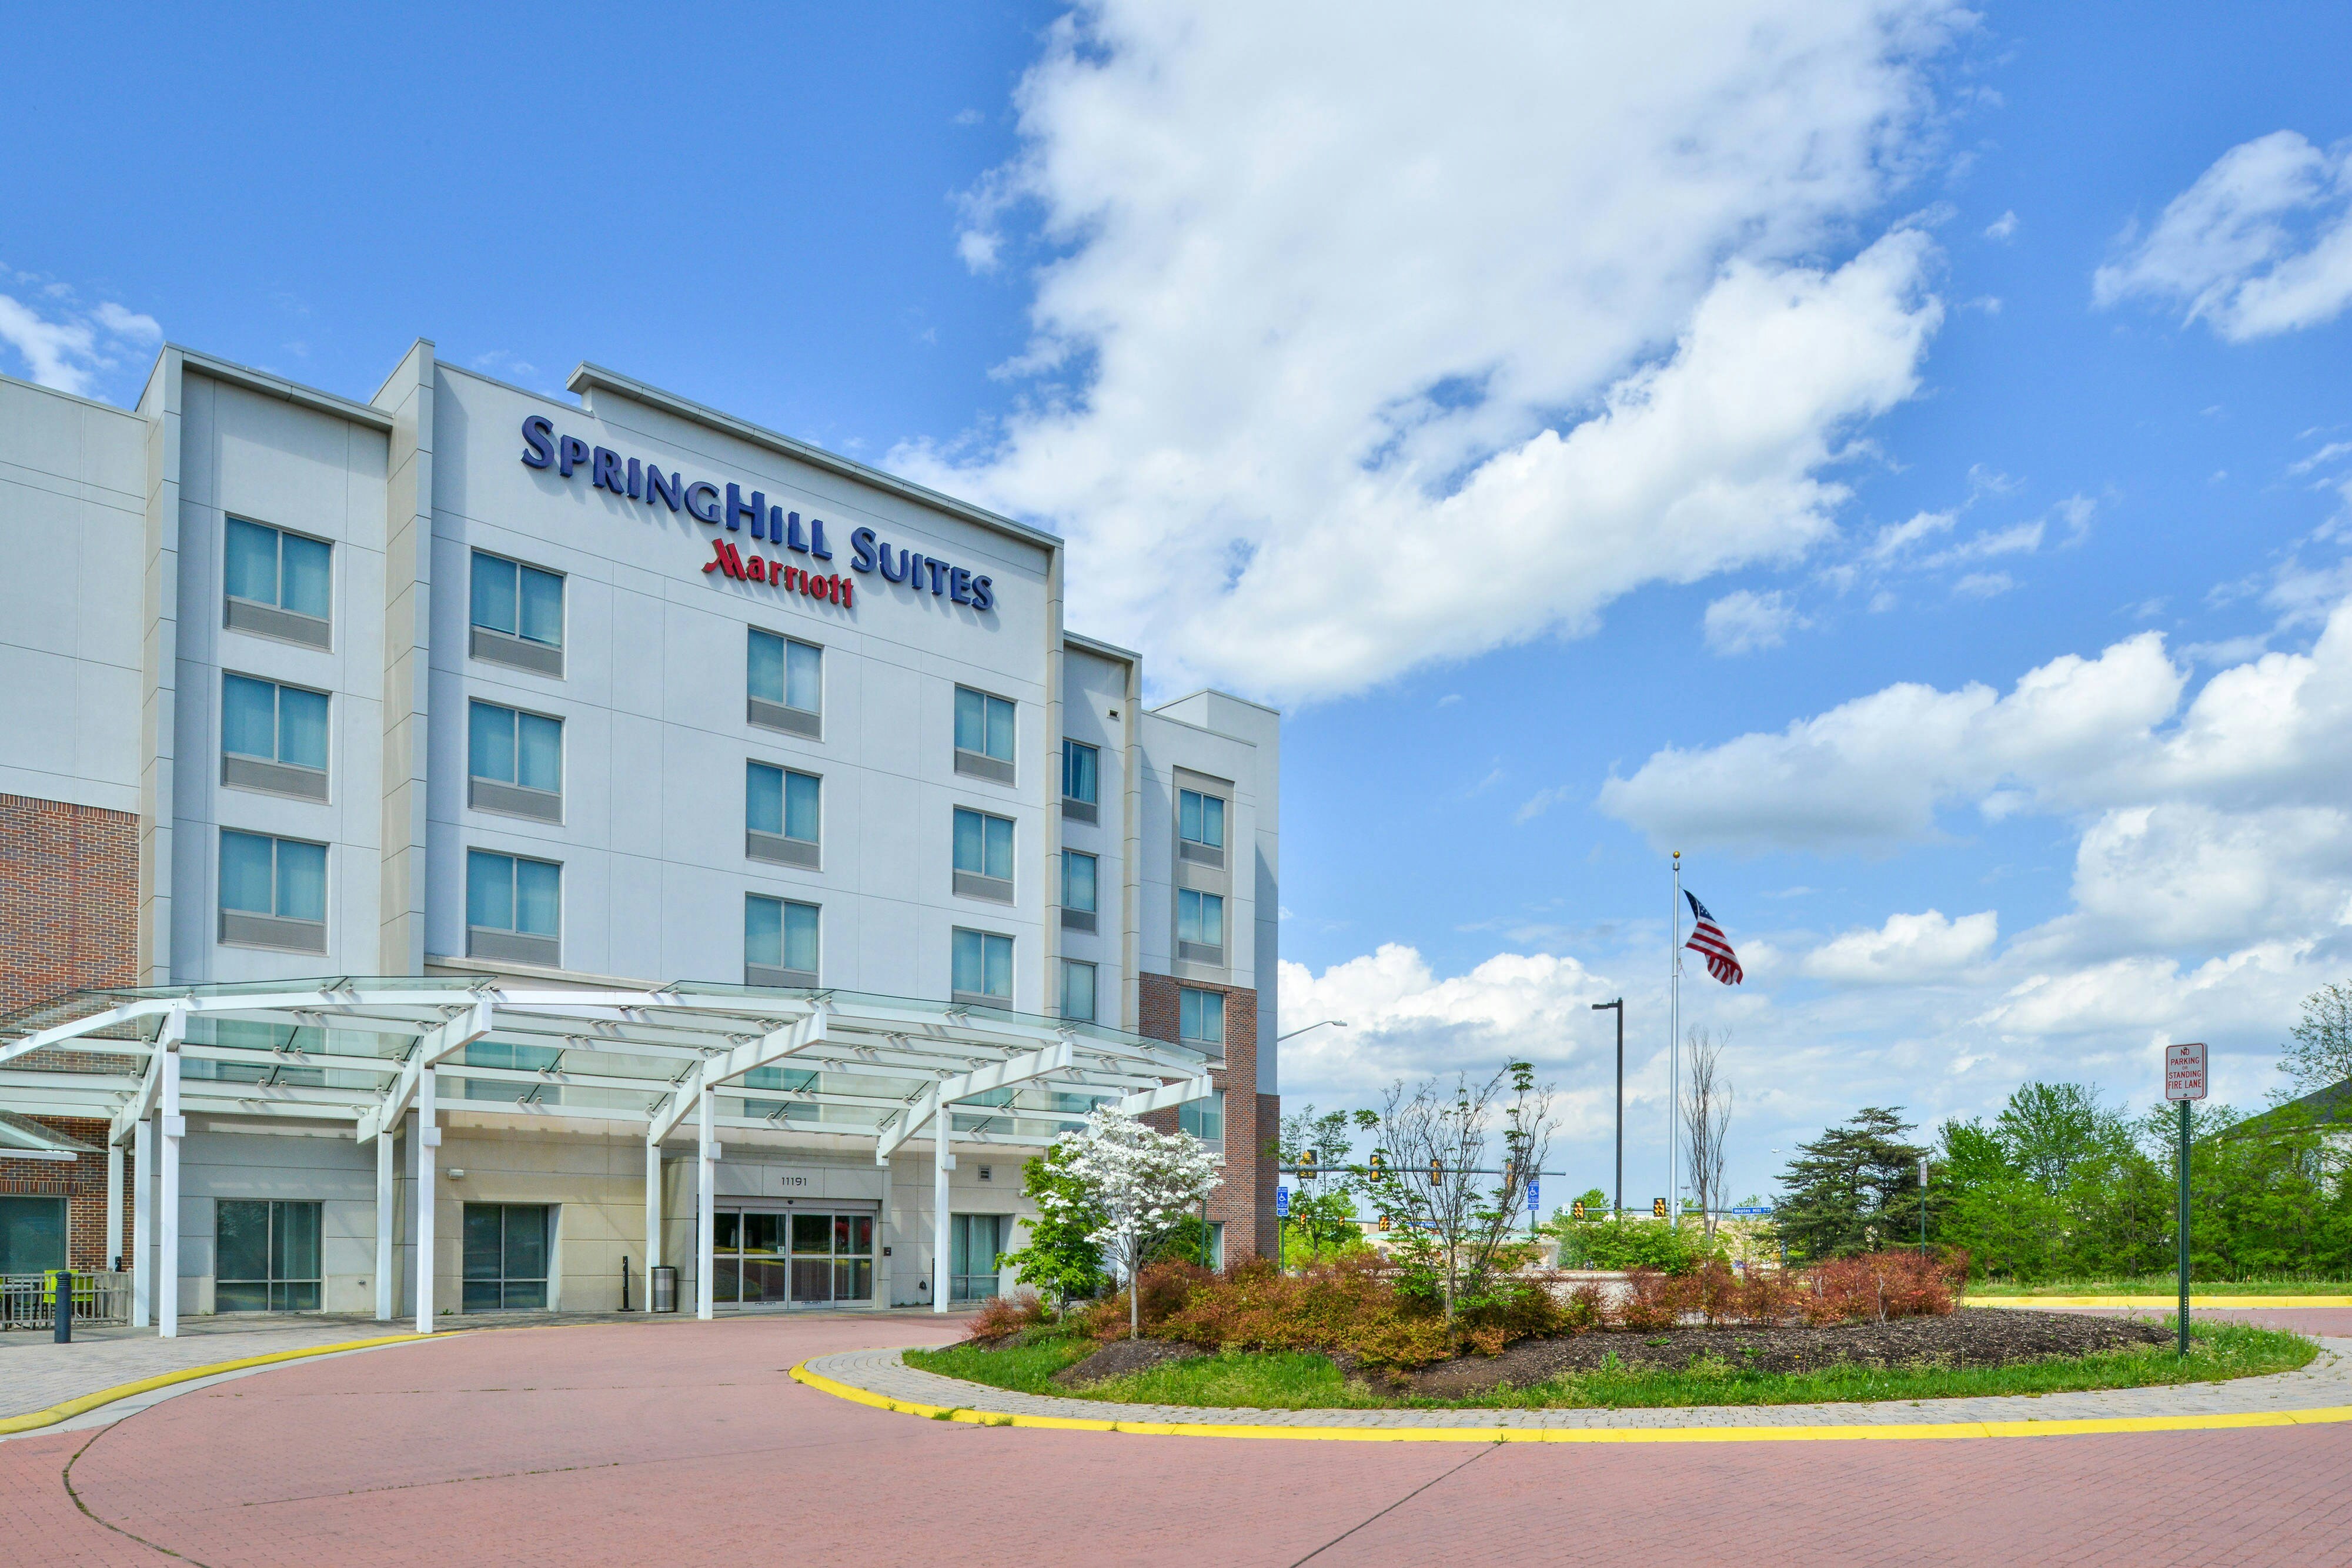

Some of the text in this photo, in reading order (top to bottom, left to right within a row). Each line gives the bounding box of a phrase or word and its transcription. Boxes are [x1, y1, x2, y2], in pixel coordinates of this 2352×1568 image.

[520, 415, 994, 610] SPRINGHILL SUITES
[701, 538, 854, 609] Marriott
[2171, 1057, 2200, 1066] PARKING
[2169, 1070, 2201, 1079] STANDING
[2168, 1079, 2201, 1089] FIRE LANE
[781, 1177, 807, 1186] 11191
